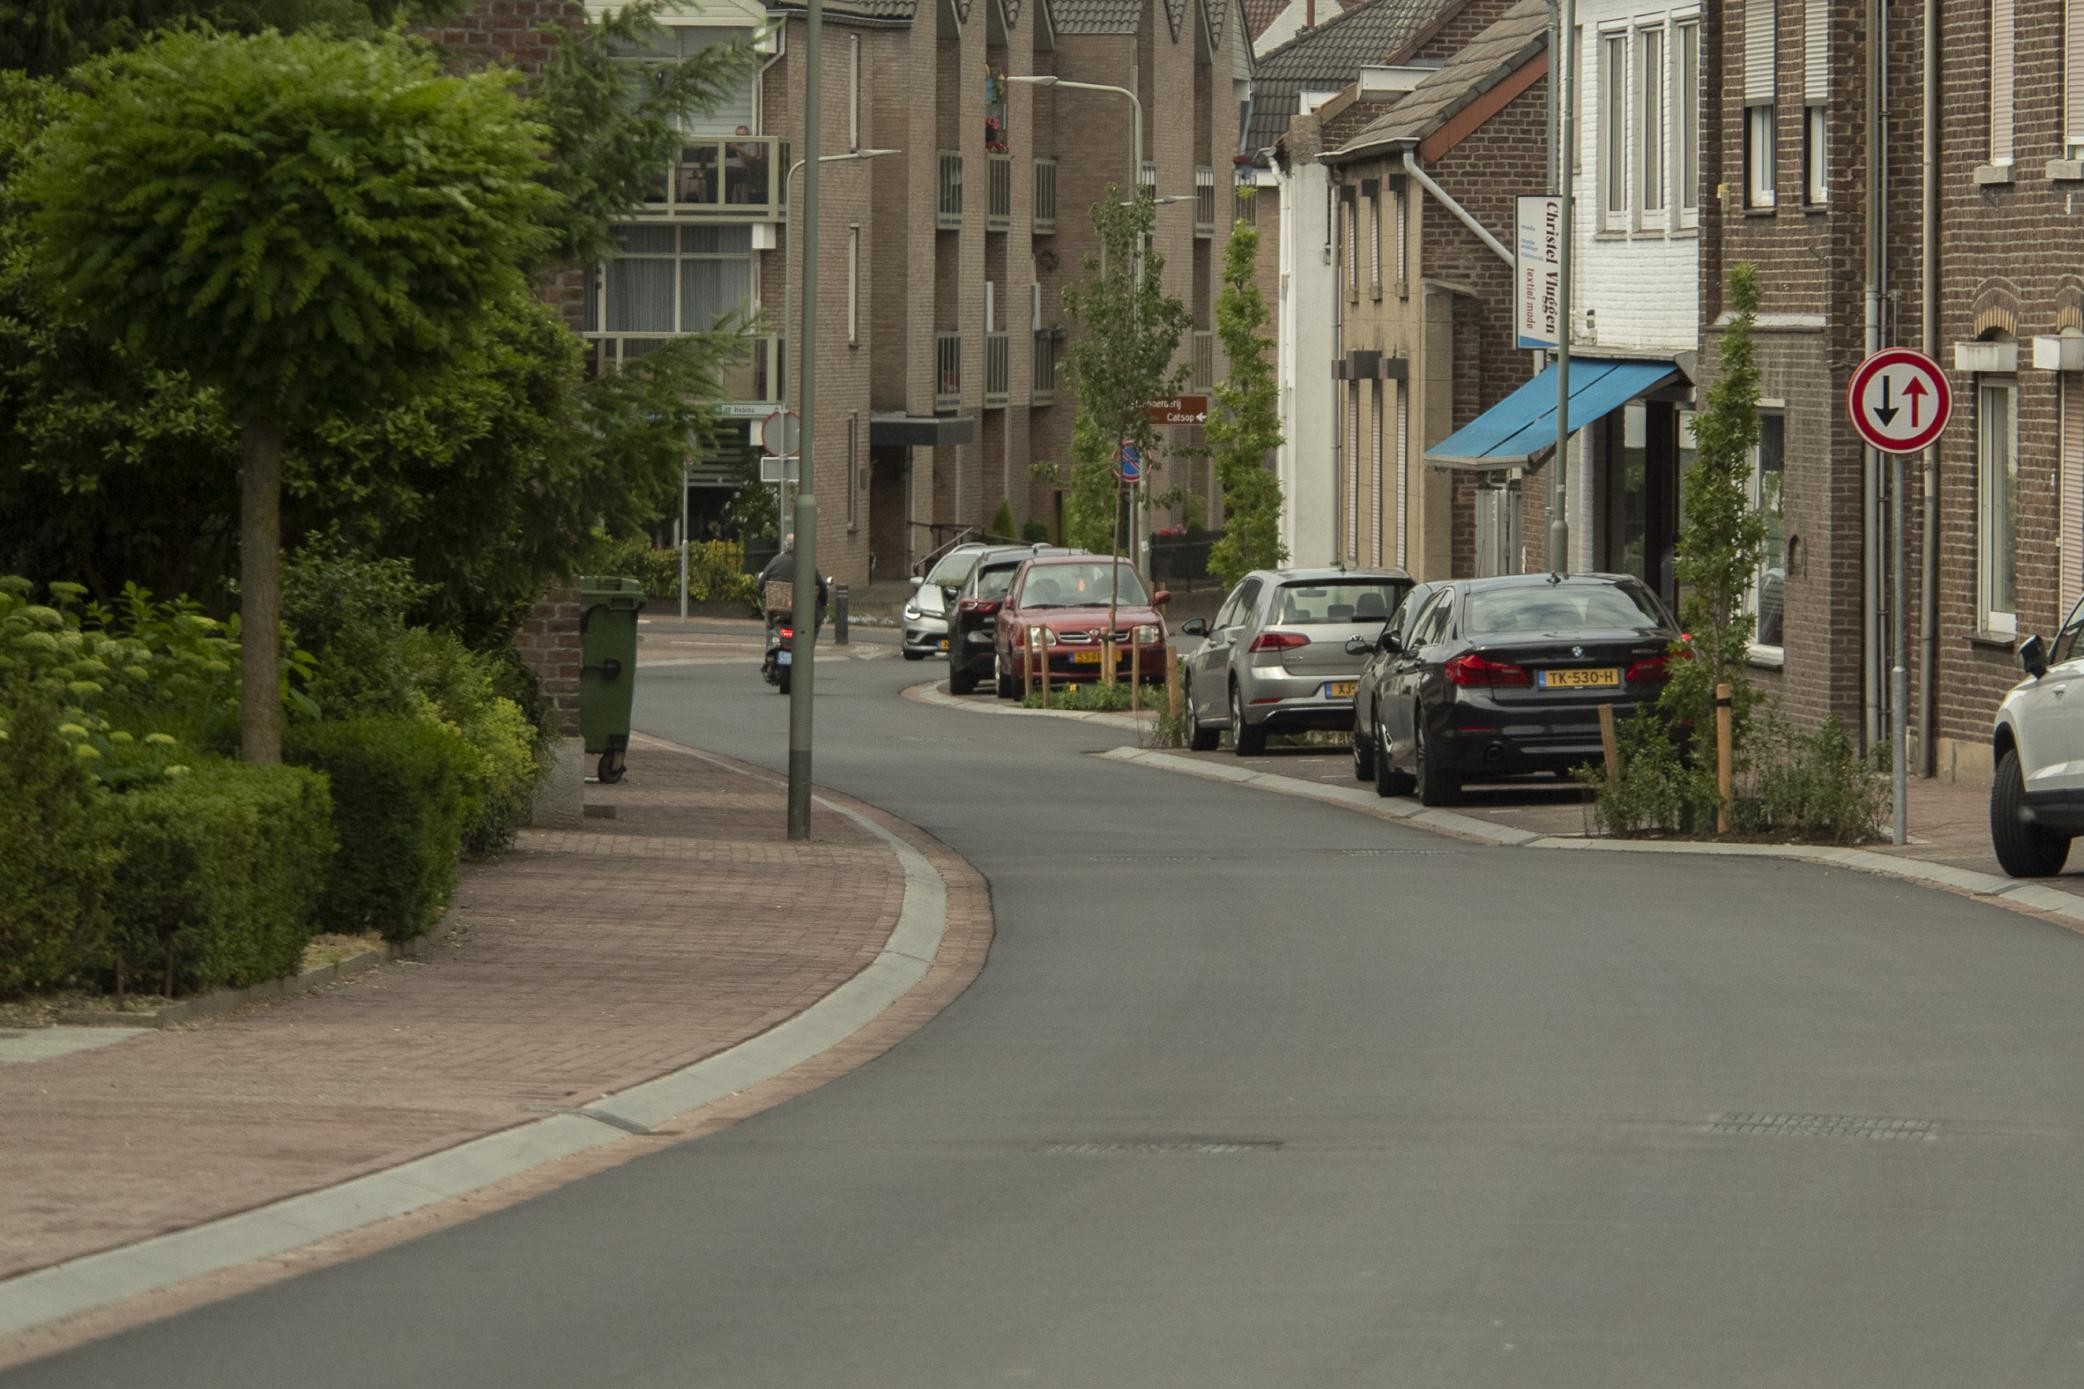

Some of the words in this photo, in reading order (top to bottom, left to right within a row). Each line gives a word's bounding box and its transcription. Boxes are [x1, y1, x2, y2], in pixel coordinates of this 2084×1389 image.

[1546, 201, 1559, 264] Christel
[1526, 268, 1536, 300] textiel
[1526, 302, 1536, 329] mode
[1542, 272, 1559, 334] Vluggen
[1167, 412, 1195, 423] Catsop
[1550, 671, 1614, 685] TK-530-H
